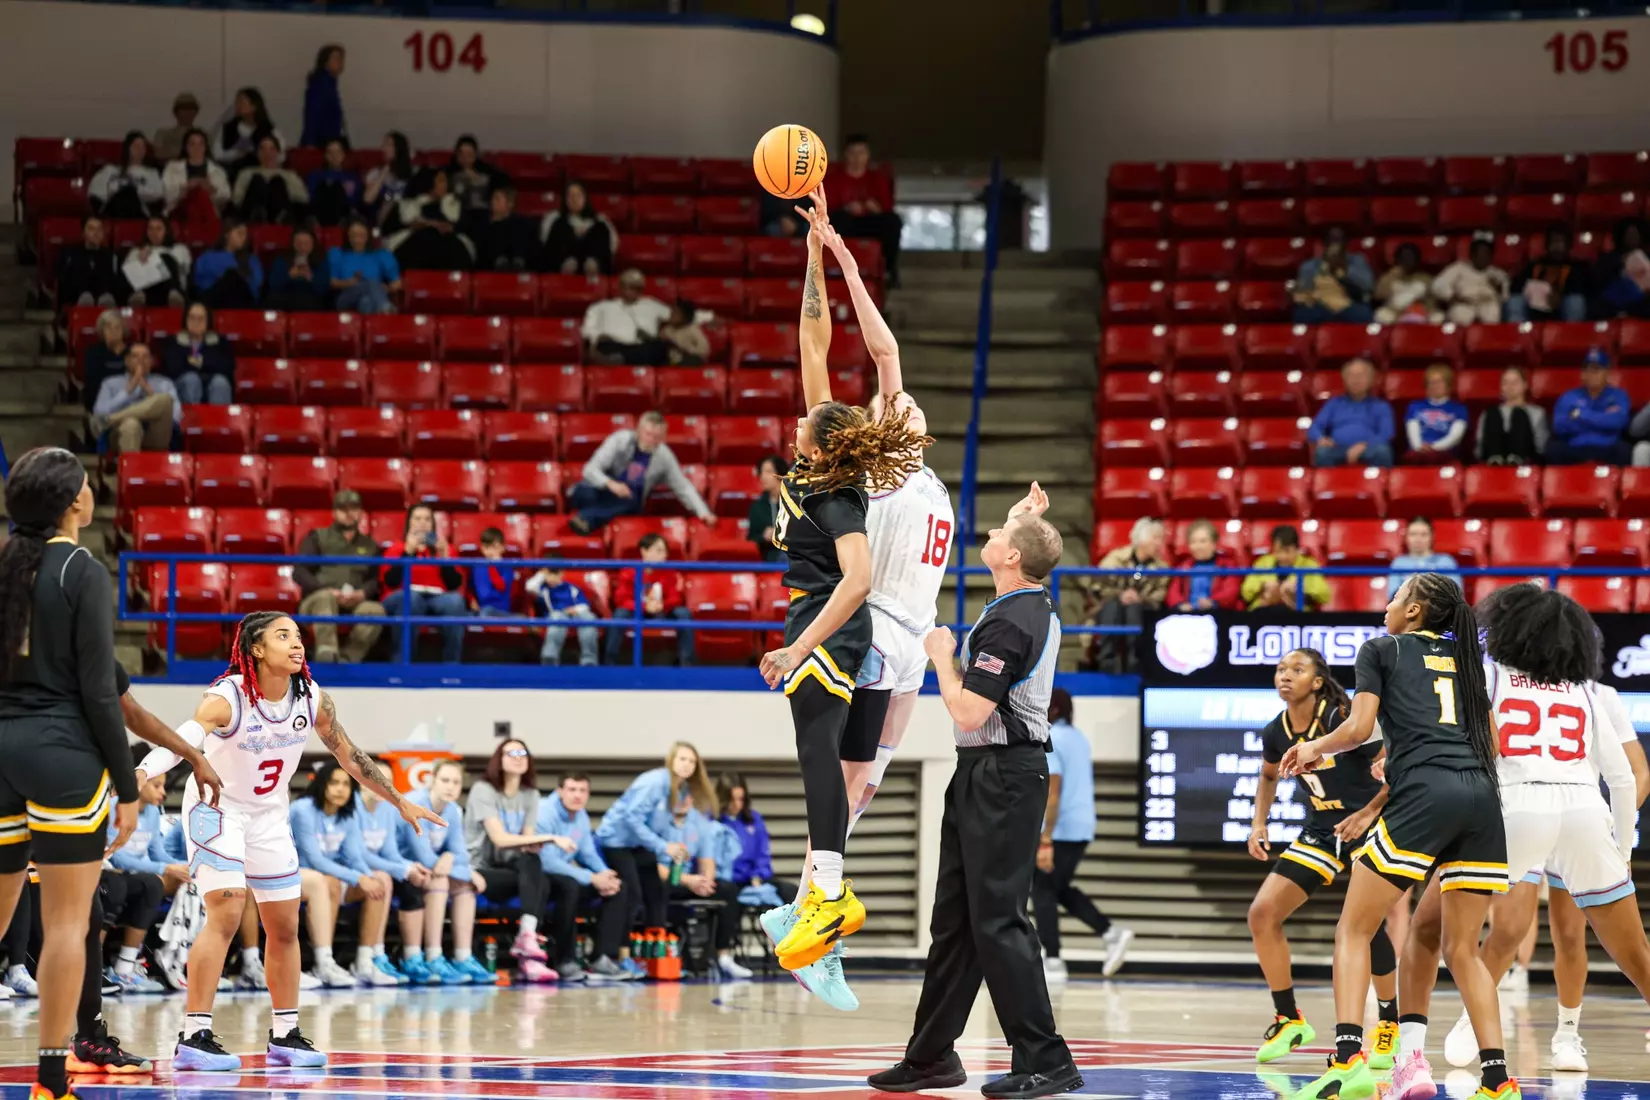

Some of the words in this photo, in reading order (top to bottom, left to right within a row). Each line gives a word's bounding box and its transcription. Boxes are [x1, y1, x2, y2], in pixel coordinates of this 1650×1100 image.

[404, 30, 488, 74] 104
[1544, 29, 1629, 74] 105
[794, 129, 810, 176] Wilson
[921, 513, 951, 567] 18
[1433, 676, 1457, 725] 1
[1151, 730, 1169, 751] 3
[1498, 698, 1587, 762] 23
[253, 759, 284, 795] 3
